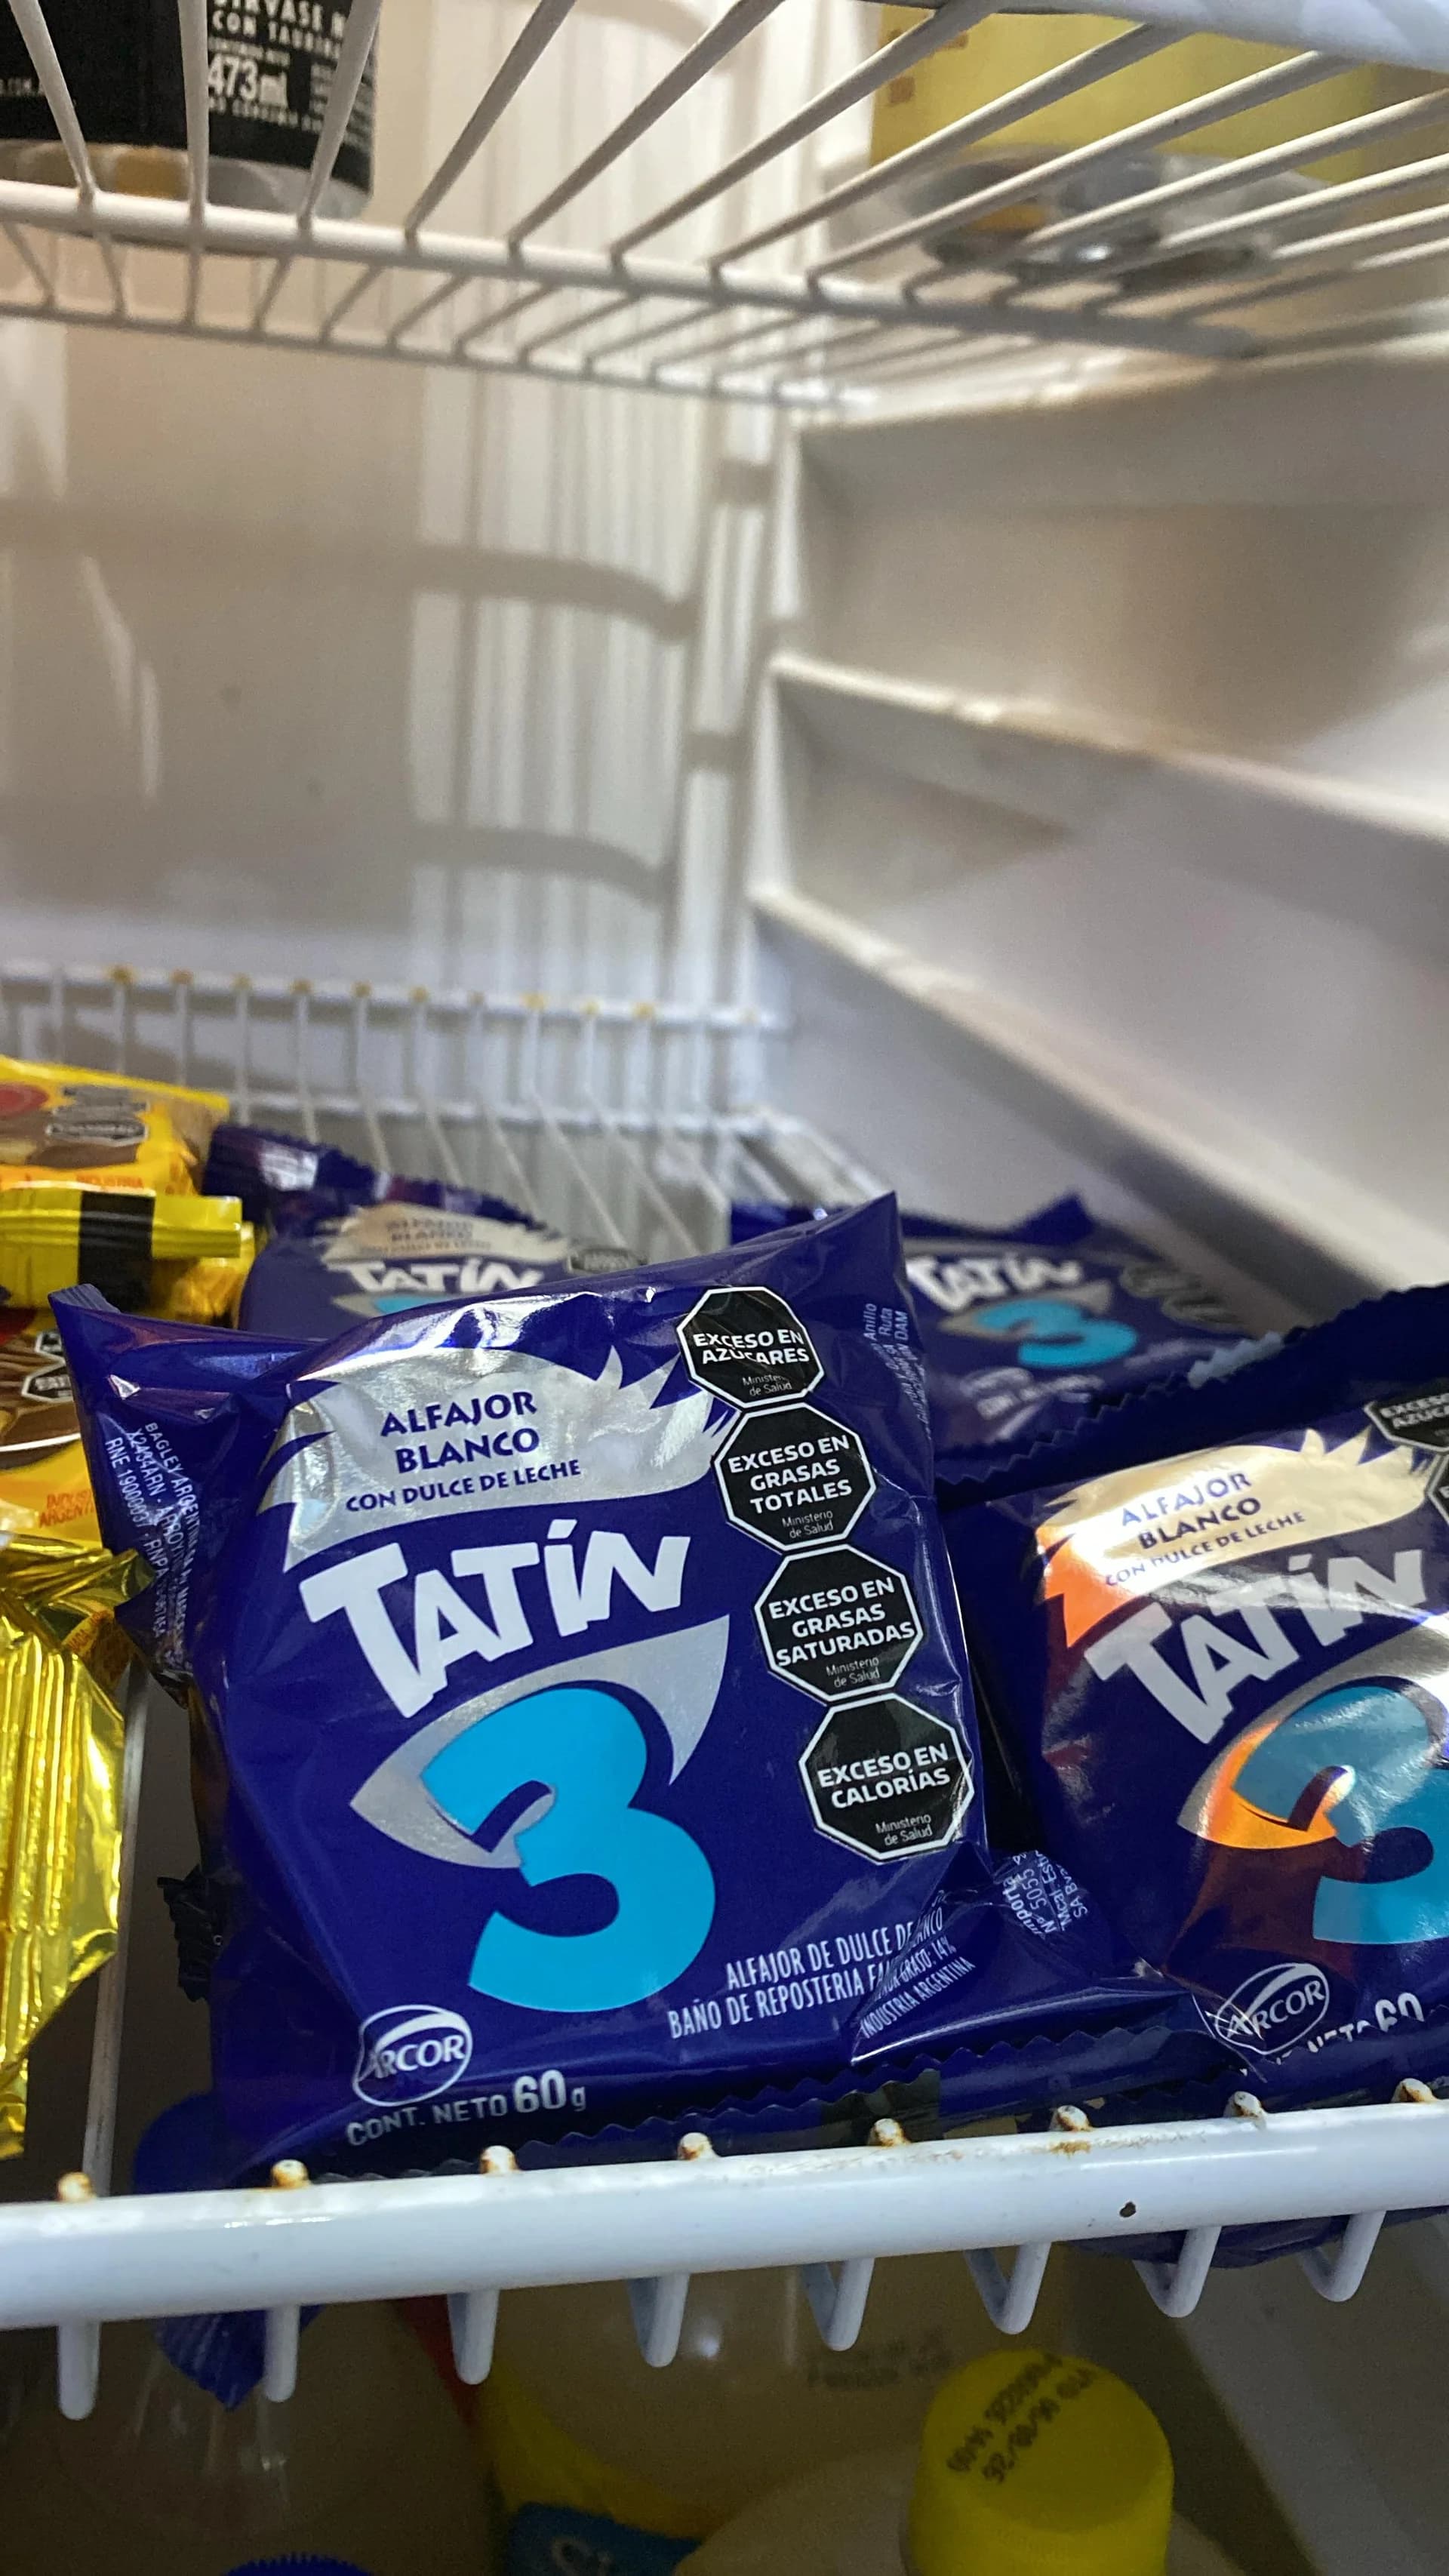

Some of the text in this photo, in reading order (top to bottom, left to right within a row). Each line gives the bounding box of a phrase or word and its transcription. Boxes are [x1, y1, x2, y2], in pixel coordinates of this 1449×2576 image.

[693, 1328, 804, 1349] EXCESO EN
[749, 1381, 792, 1396] de Salud
[380, 1391, 537, 1437] ALFAJOR
[105, 1437, 131, 1469] RNE
[145, 1422, 184, 1473] BAGLEY
[395, 1427, 540, 1474] BLANCO
[728, 1434, 851, 1474] EXCESO EN
[345, 1459, 581, 1512] CON DULCE DE LECHE
[749, 1459, 841, 1492] GRASAS
[749, 1479, 853, 1515] TOTALES
[782, 1510, 834, 1528] Ministerio
[1121, 1472, 1253, 1528] ALFAJOR
[789, 1519, 834, 1540] de Salud
[1137, 1497, 1262, 1550] BLANCO
[1105, 1559, 1146, 1587] CON
[1218, 1530, 1244, 1550] DE
[1244, 1510, 1306, 1540] LECHE
[299, 1519, 691, 1719] TATÍN
[768, 1576, 896, 1620] EXCESO EN
[791, 1602, 887, 1639] GRASAS
[776, 1621, 915, 1668] SATURADAS
[826, 1655, 880, 1678] Ministerio
[1084, 1549, 1426, 1745] TATÍN
[833, 1668, 881, 1688] de Salud
[817, 1742, 949, 1789] EXCESO EN
[831, 1766, 952, 1810] CALORÍAS
[875, 1812, 932, 1835] Ministerio
[884, 1824, 934, 1846] de Salud
[1232, 1685, 1449, 1945] 3
[420, 1688, 715, 2013] 3
[724, 1947, 805, 1990] ALFAJOR
[808, 1940, 832, 1968] DE
[837, 1926, 894, 1965] DULCE
[668, 1998, 723, 2039] BAÑO
[727, 1994, 753, 2025] DE
[757, 1968, 865, 2017] REPOSTERIA
[860, 1956, 977, 2039] INDUSTRIA ARGENTINA
[346, 2107, 426, 2146] CONT.
[432, 2094, 509, 2125] NETO
